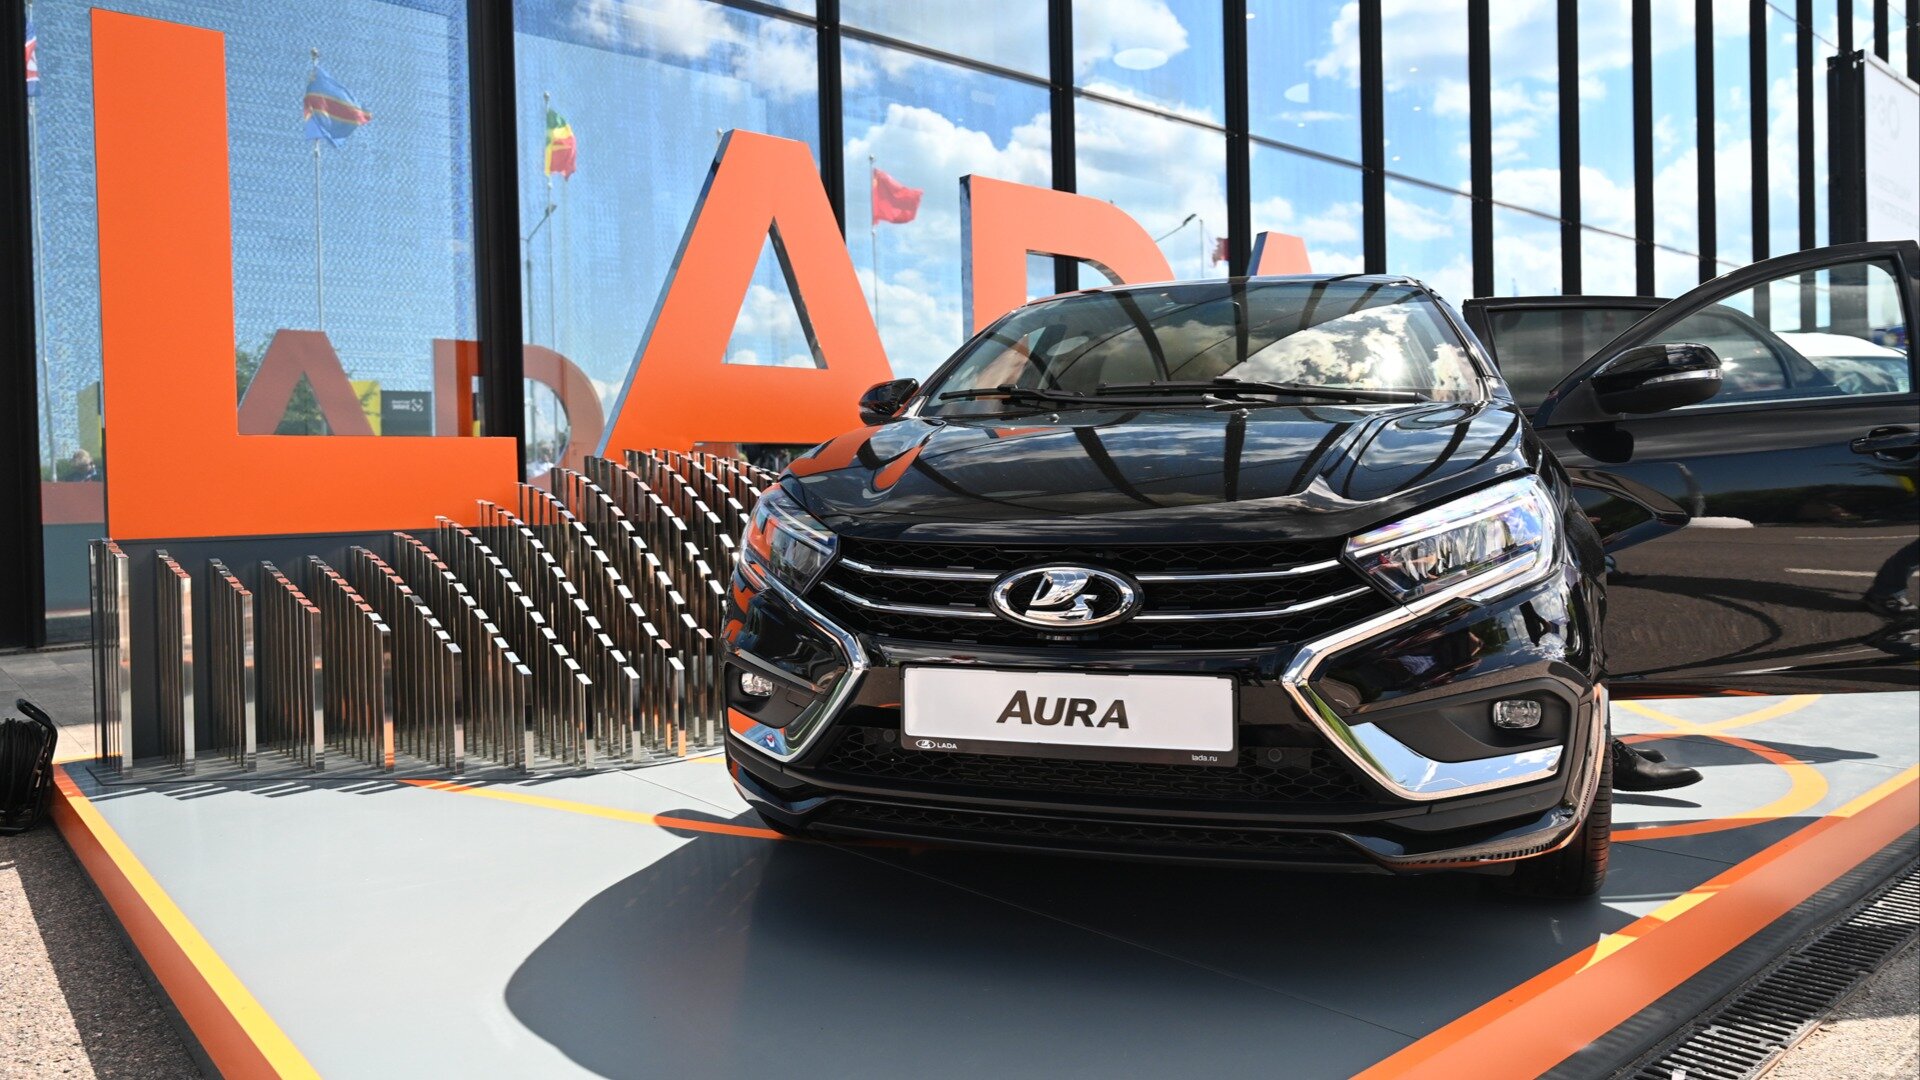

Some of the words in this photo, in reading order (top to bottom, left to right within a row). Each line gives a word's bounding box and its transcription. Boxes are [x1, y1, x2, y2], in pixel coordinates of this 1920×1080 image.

[92, 8, 1312, 538] LAD
[995, 690, 1130, 729] AURA
[936, 742, 958, 750] LADA
[1191, 754, 1218, 762] lada.ru
